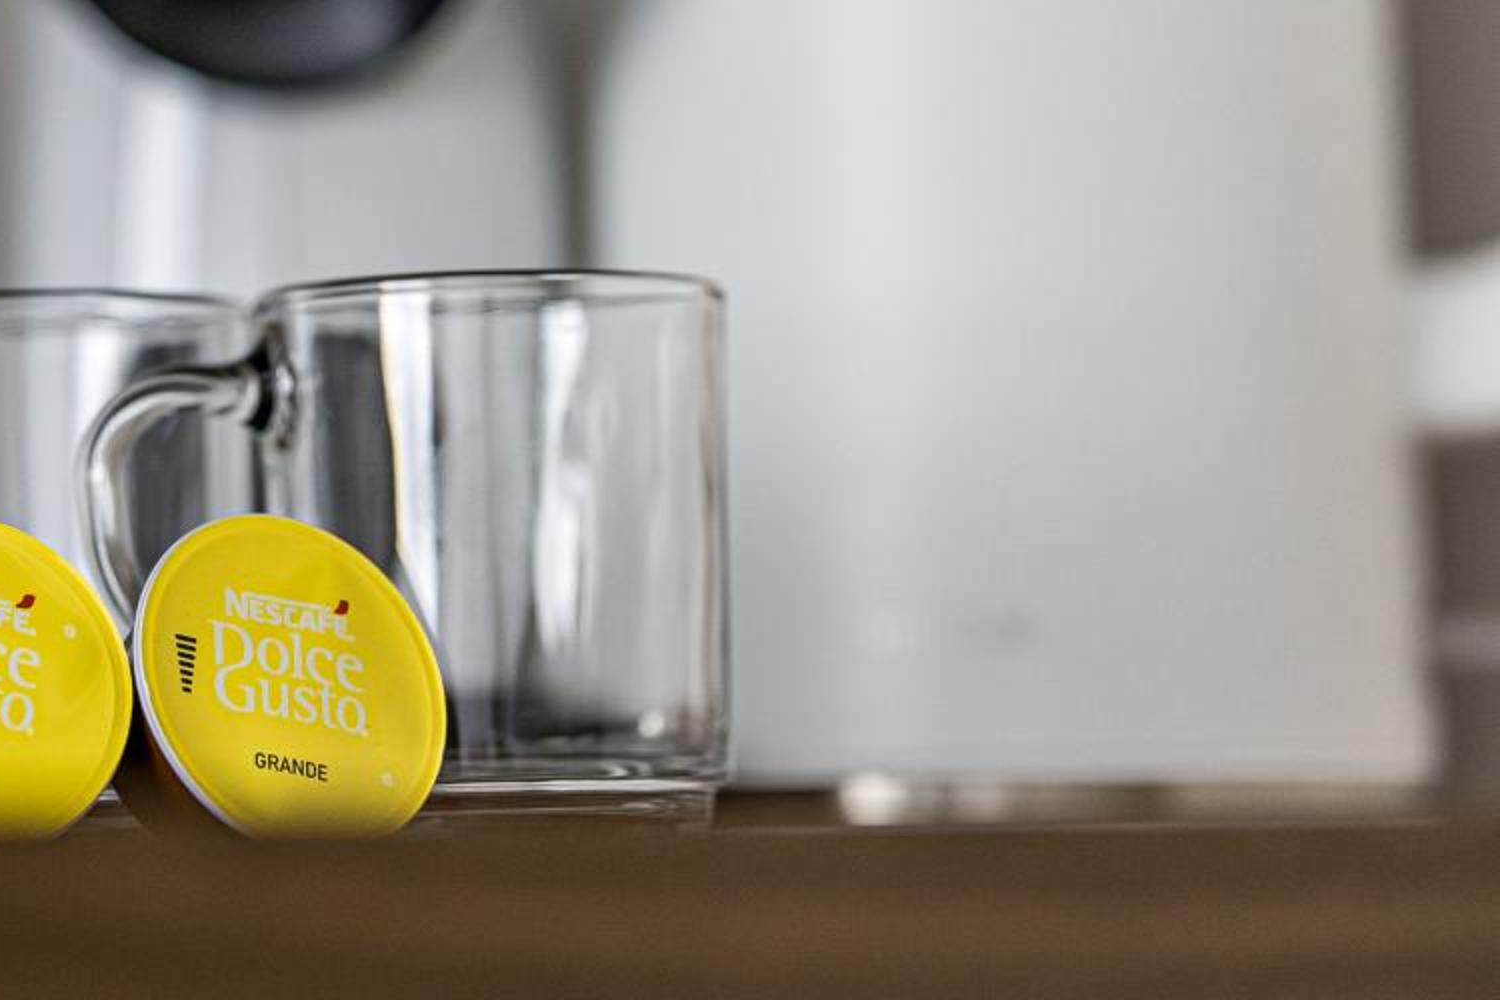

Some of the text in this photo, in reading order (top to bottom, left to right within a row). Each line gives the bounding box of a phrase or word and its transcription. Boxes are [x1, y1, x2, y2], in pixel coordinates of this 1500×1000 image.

[210, 620, 364, 693] Dolce
[214, 666, 368, 737] Gusto
[254, 751, 328, 782] GRANDE
